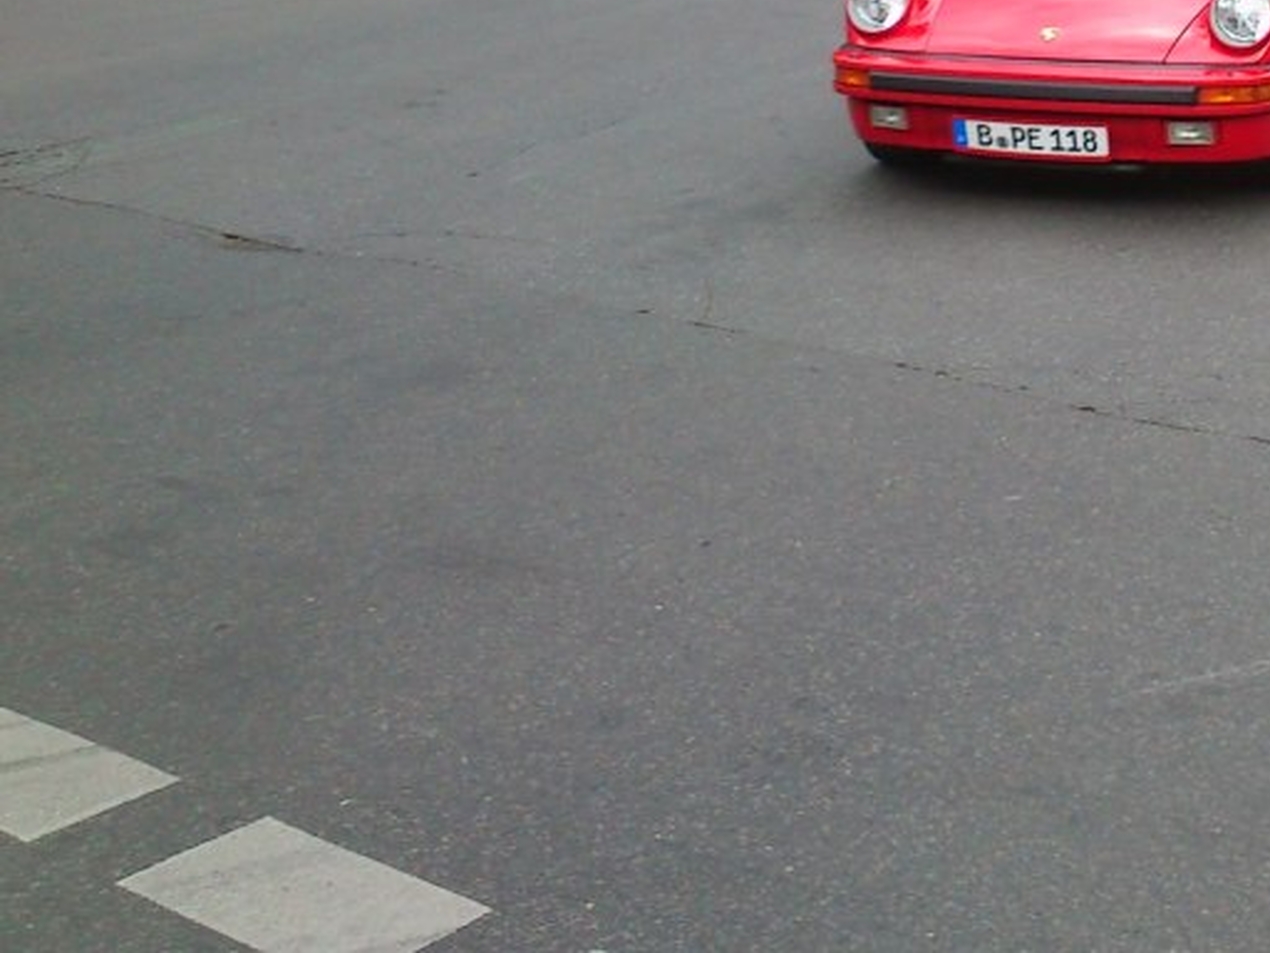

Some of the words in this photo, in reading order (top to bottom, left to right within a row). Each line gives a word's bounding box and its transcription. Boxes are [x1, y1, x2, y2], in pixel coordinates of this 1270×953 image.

[976, 124, 993, 147] B
[1010, 126, 1045, 150] PE
[1050, 129, 1098, 153] 118
